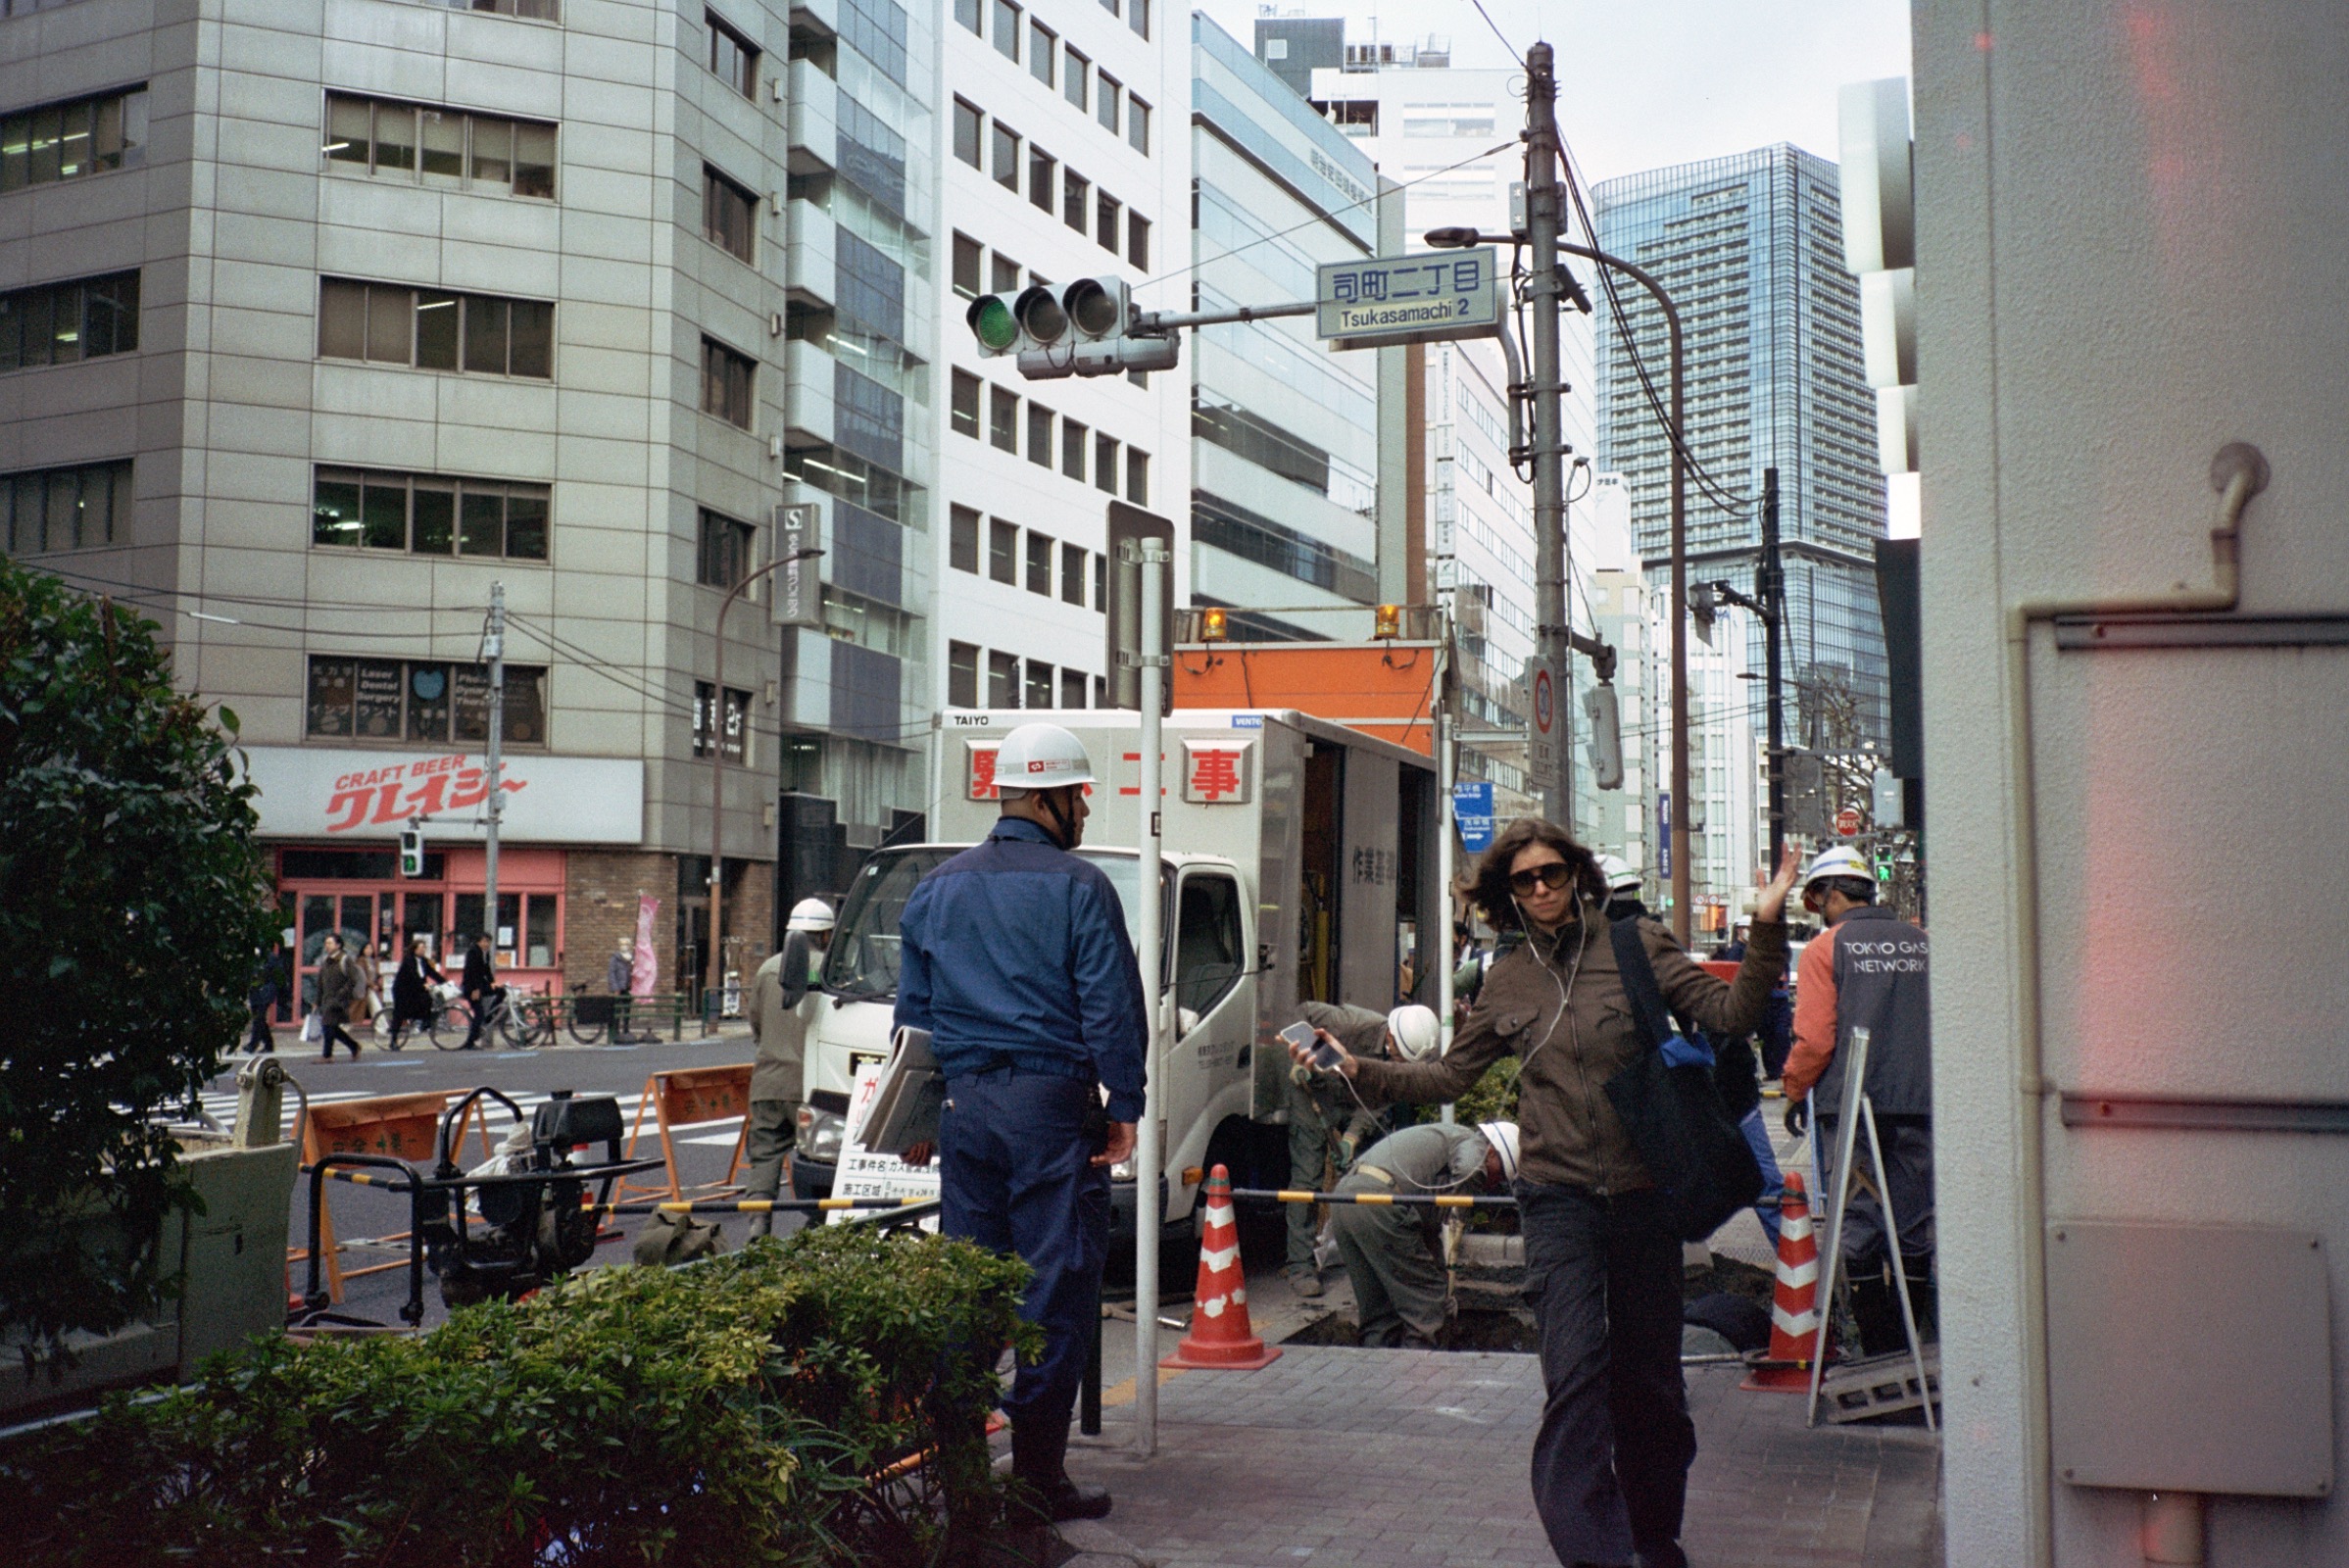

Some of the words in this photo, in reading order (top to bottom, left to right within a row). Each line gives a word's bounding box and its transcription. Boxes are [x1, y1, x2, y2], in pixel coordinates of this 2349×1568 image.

[1333, 260, 1479, 303] 司町二丁目
[1342, 301, 1452, 327] Tsukasamachi
[1457, 298, 1469, 316] 2
[361, 668, 393, 679] Laser
[360, 680, 398, 690] Dental
[356, 692, 401, 704] Surgery
[954, 715, 989, 726] TAIYO
[335, 764, 407, 791] CRAFT
[411, 754, 466, 777] BEER
[1844, 942, 1895, 955] TOKYO
[1899, 942, 1929, 954] GAS
[1854, 958, 1926, 973] NETWORK
[848, 1158, 886, 1172] 工事件名
[843, 1183, 882, 1197] 施工区域
